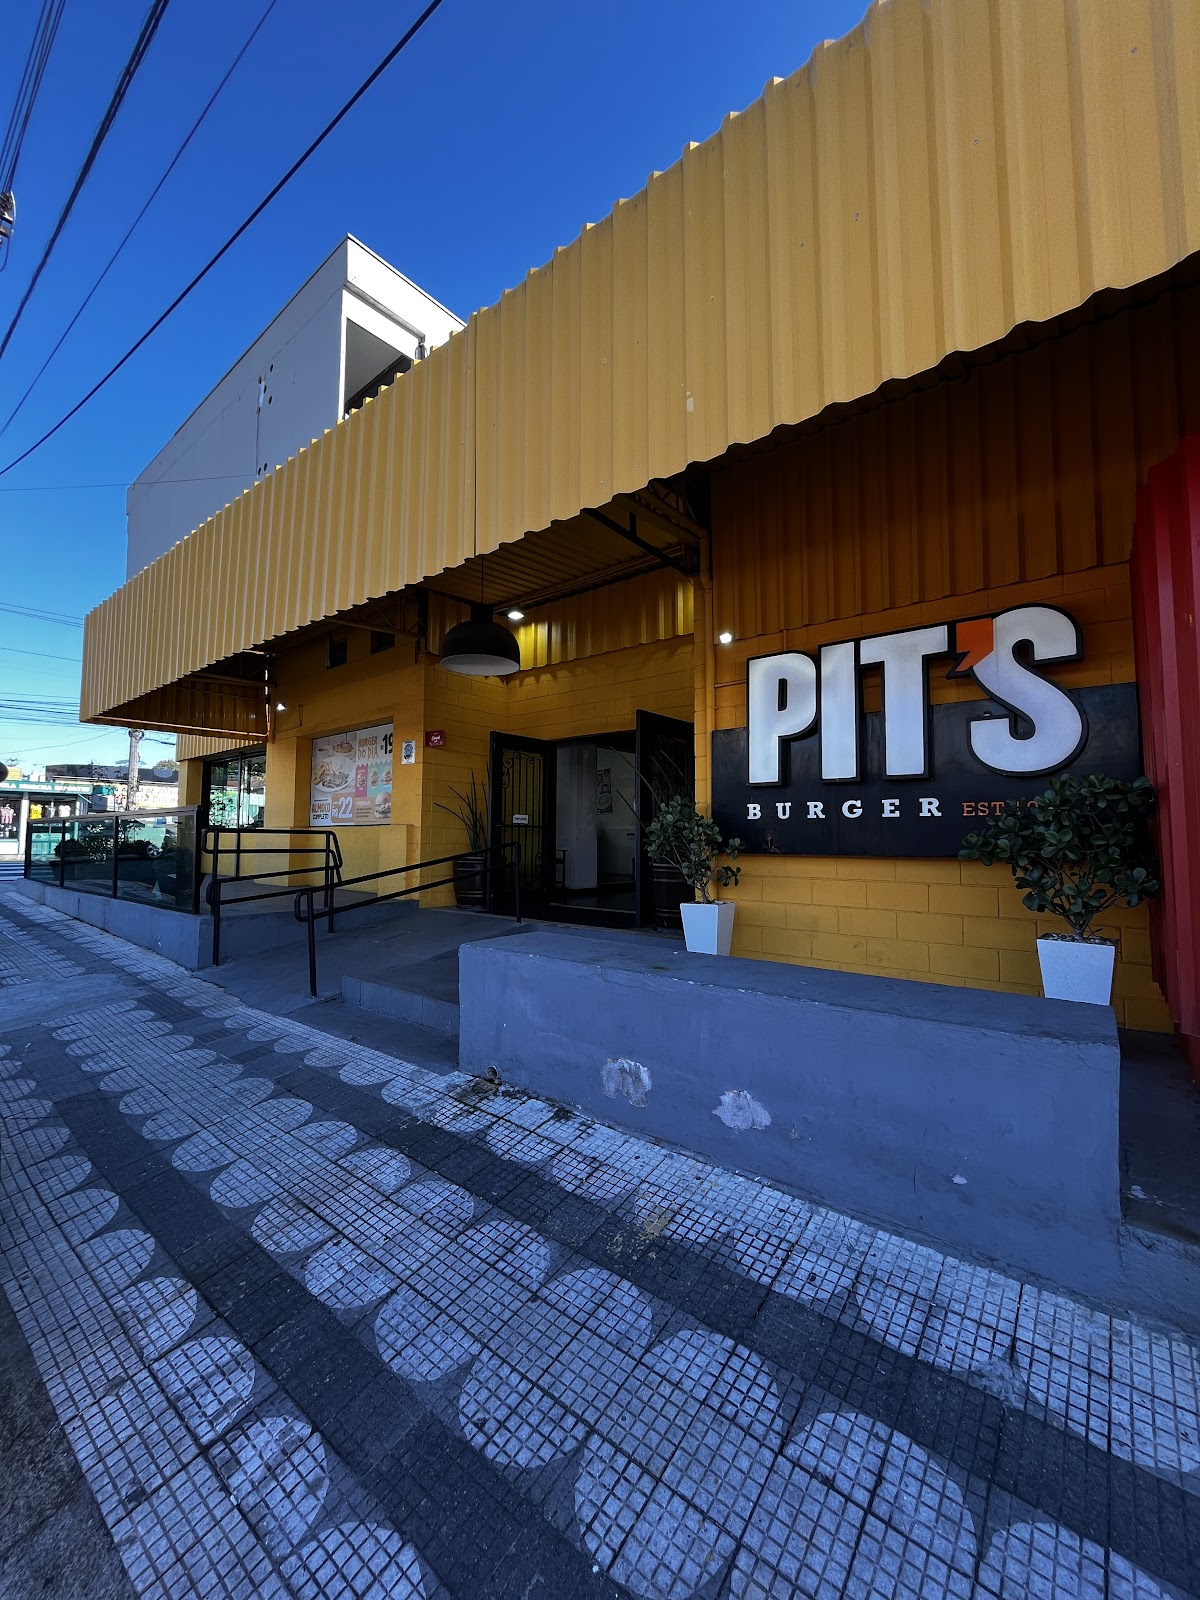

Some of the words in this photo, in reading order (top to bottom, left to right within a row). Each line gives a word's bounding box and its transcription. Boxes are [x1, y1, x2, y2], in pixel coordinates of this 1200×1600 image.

[747, 605, 1085, 786] PIT'S
[358, 736, 378, 747] BURGER
[338, 796, 353, 819] 22
[747, 797, 942, 820] BURGER
[962, 801, 1005, 816] EST
